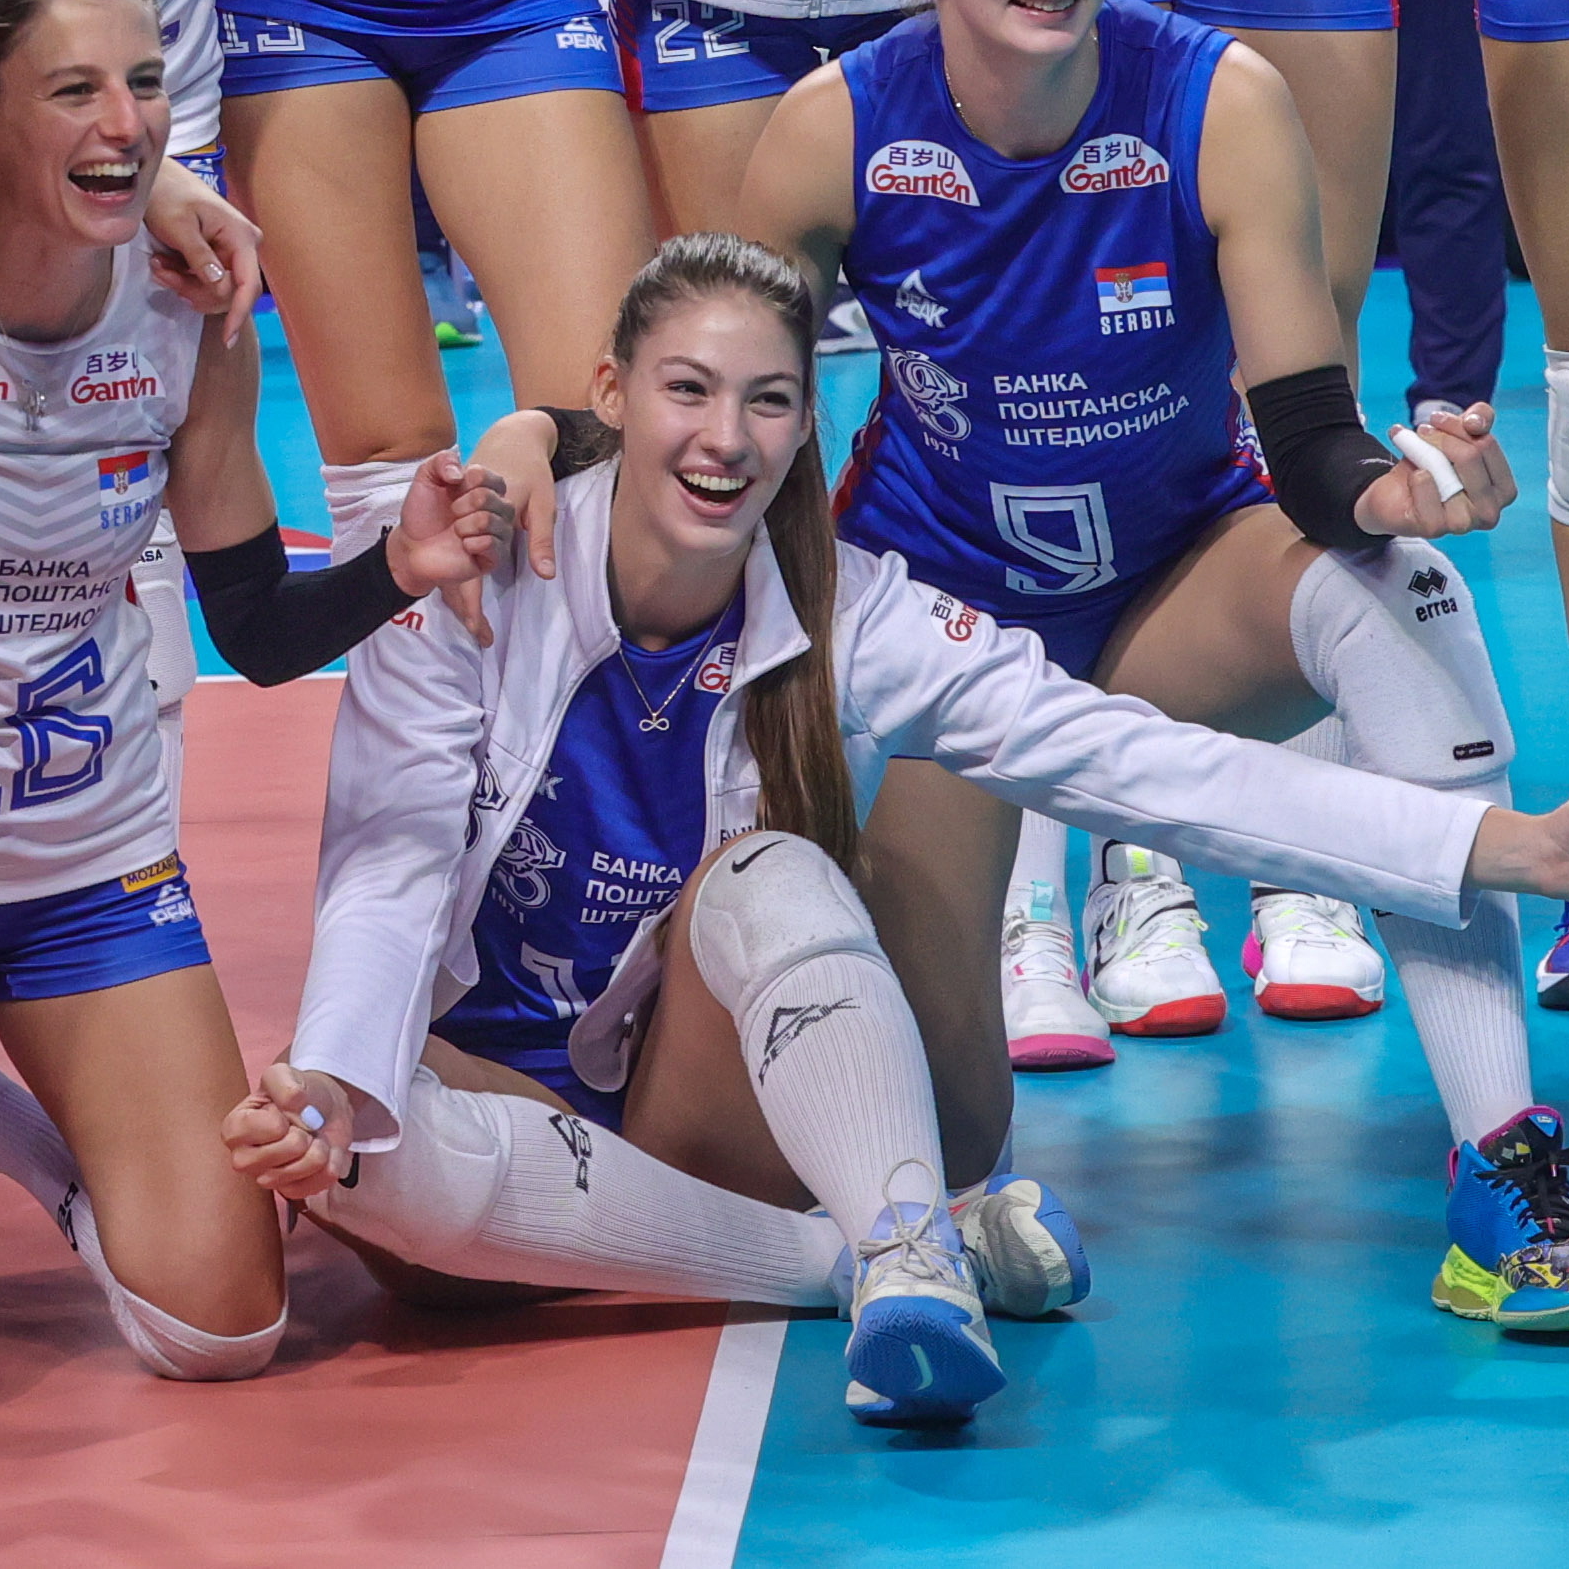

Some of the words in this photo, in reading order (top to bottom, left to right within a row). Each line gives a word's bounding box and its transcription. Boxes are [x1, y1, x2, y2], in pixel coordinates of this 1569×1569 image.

[556, 31, 608, 54] PEAK
[887, 146, 957, 171] 百岁山
[1081, 139, 1144, 165] 百岁山
[871, 163, 972, 204] Ganten
[1065, 155, 1168, 193] Ganten
[895, 286, 950, 330] PEAK
[1099, 308, 1177, 336] SERBIA
[993, 372, 1088, 395] БАНКА
[998, 381, 1173, 420] ПОШТАНСКА
[1003, 394, 1190, 448] ШТЕДИОНИЦА
[921, 433, 962, 463] 1921
[989, 480, 1119, 596] 9
[591, 851, 684, 885] БАНКА
